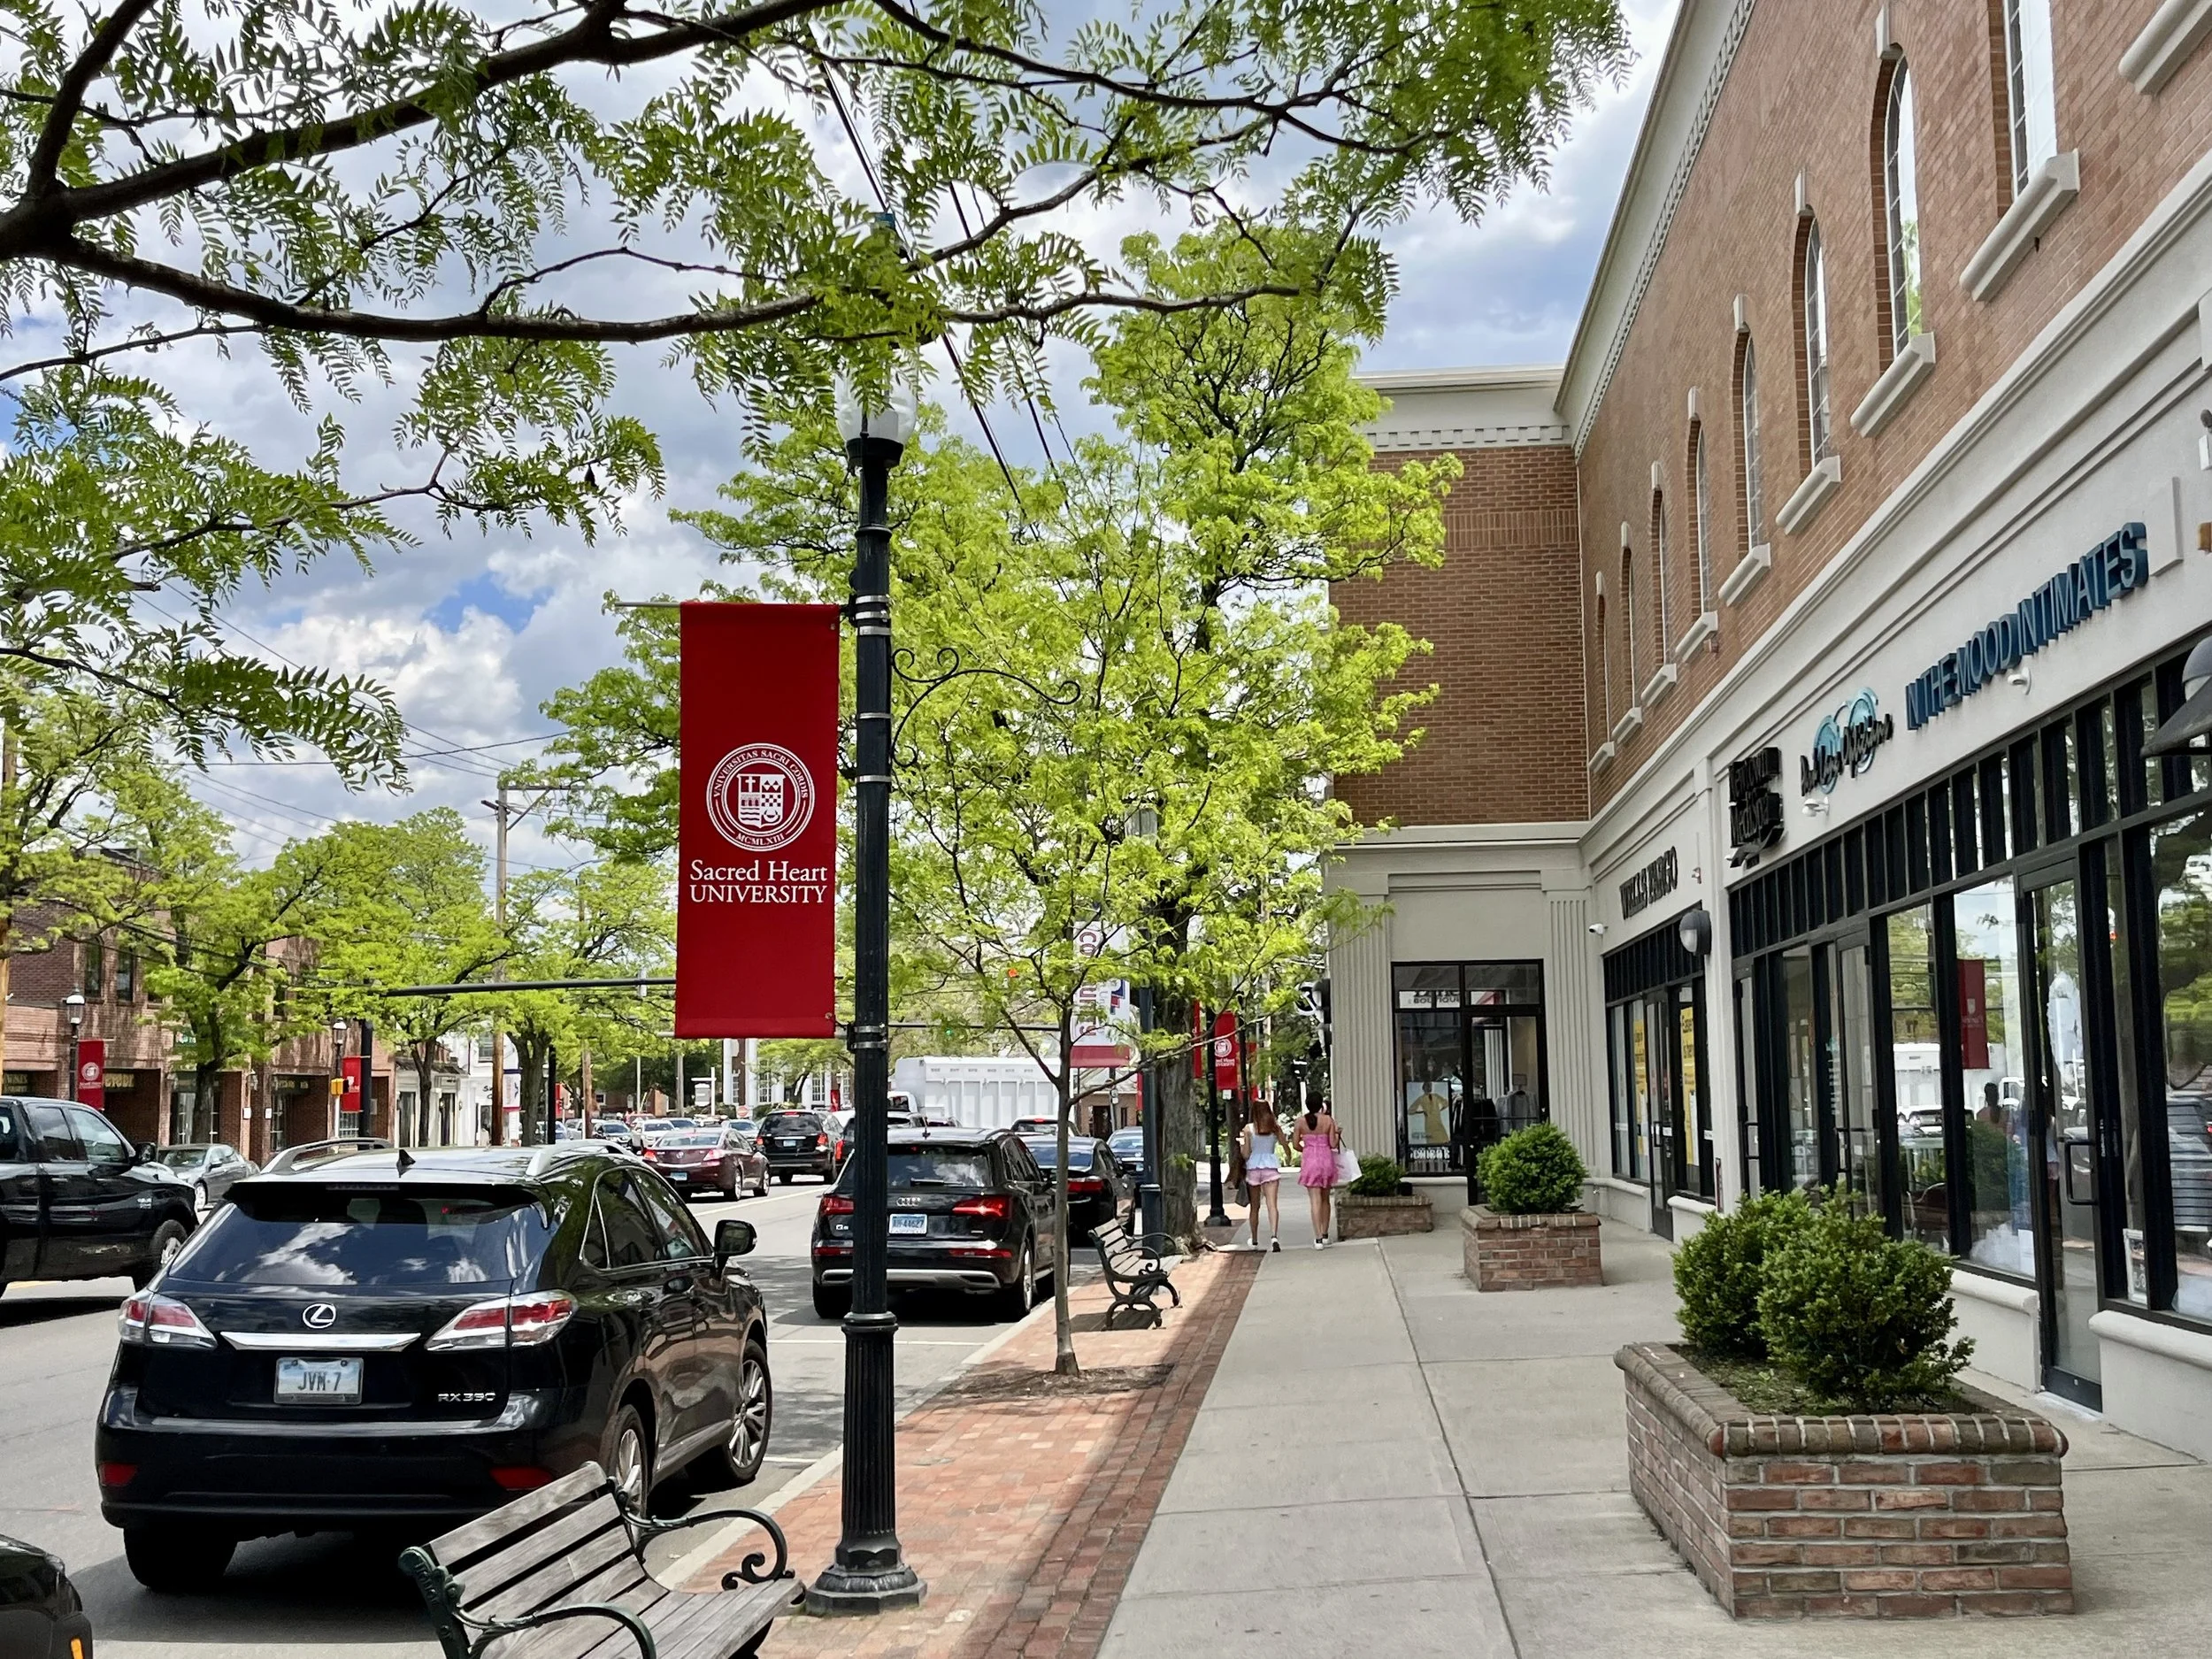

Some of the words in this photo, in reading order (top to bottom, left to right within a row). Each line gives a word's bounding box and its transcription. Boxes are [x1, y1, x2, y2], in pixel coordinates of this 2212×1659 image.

[1921, 653, 1963, 718] THE
[1956, 613, 2023, 697] MOOD
[2017, 522, 2149, 656] INTIMATES
[761, 749, 790, 766] SACRI
[789, 764, 809, 799] CORDIS
[690, 859, 761, 881] Sacred
[767, 860, 828, 882] Heart
[690, 885, 828, 903] UNIVERSITY
[1646, 845, 1678, 904] FARGO
